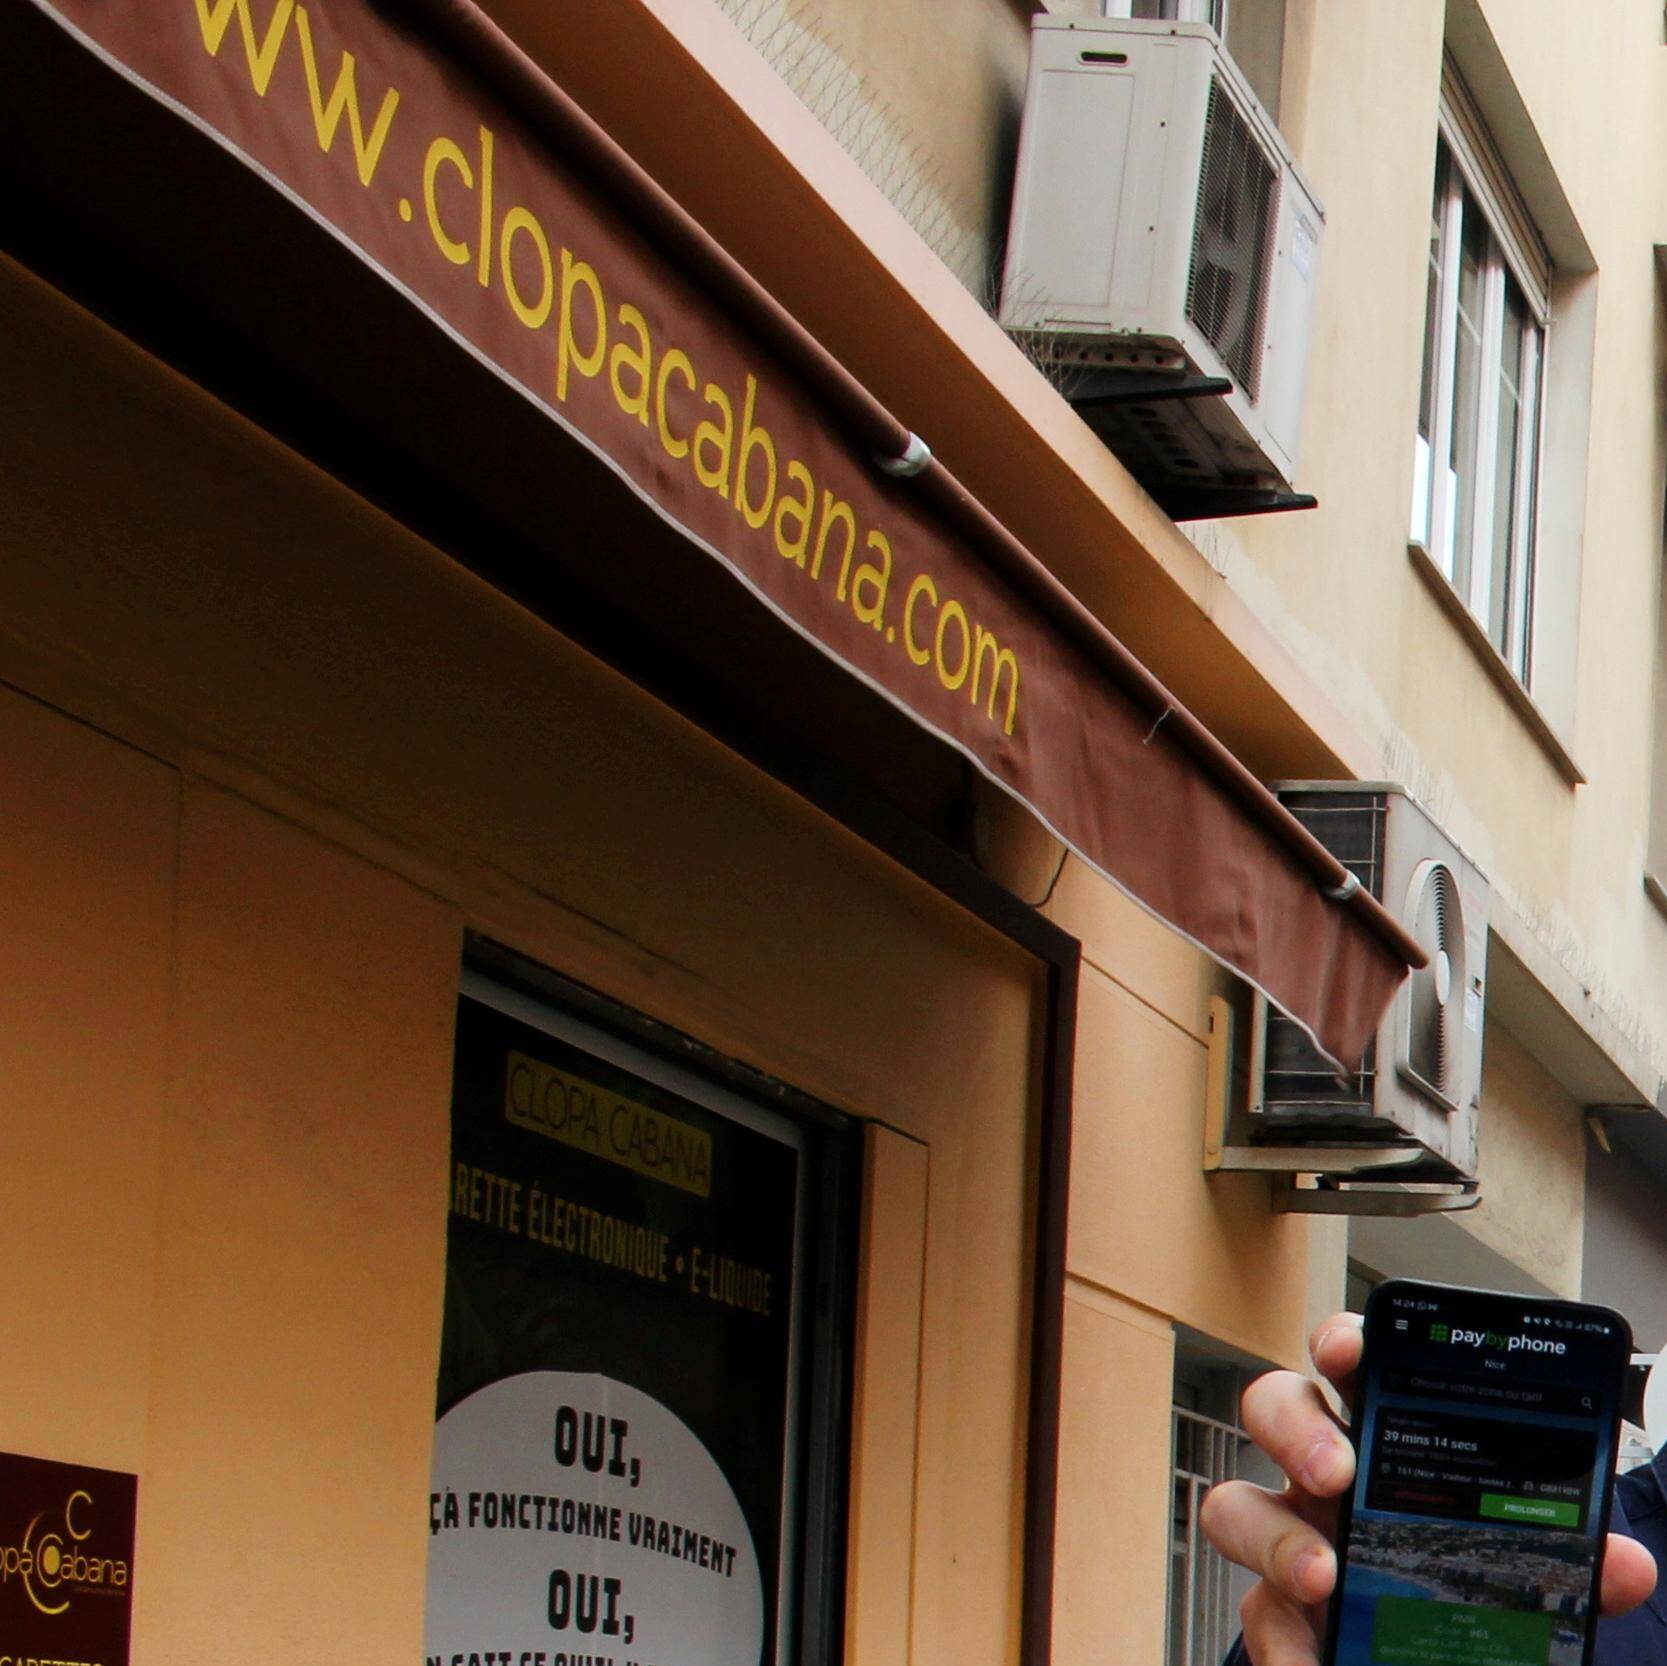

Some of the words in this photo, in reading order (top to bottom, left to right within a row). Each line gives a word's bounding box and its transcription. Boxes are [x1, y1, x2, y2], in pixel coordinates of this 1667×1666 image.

[509, 1063, 600, 1142] CLOPA
[609, 1104, 706, 1182] CABANA
[528, 1181, 671, 1283] ÉLECTRONIQUE
[689, 1246, 774, 1317] E-LIQUIDE
[1451, 1326, 1566, 1356] paybyphone
[554, 1404, 641, 1488] OUI,
[1384, 1430, 1399, 1442] 39
[1401, 1433, 1431, 1448] mins
[1433, 1436, 1448, 1448] 14
[1450, 1440, 1479, 1453] secs
[469, 1492, 622, 1542] FONCTIONNE
[629, 1511, 738, 1578] VRAIMENT
[547, 1568, 635, 1645] OUI,
